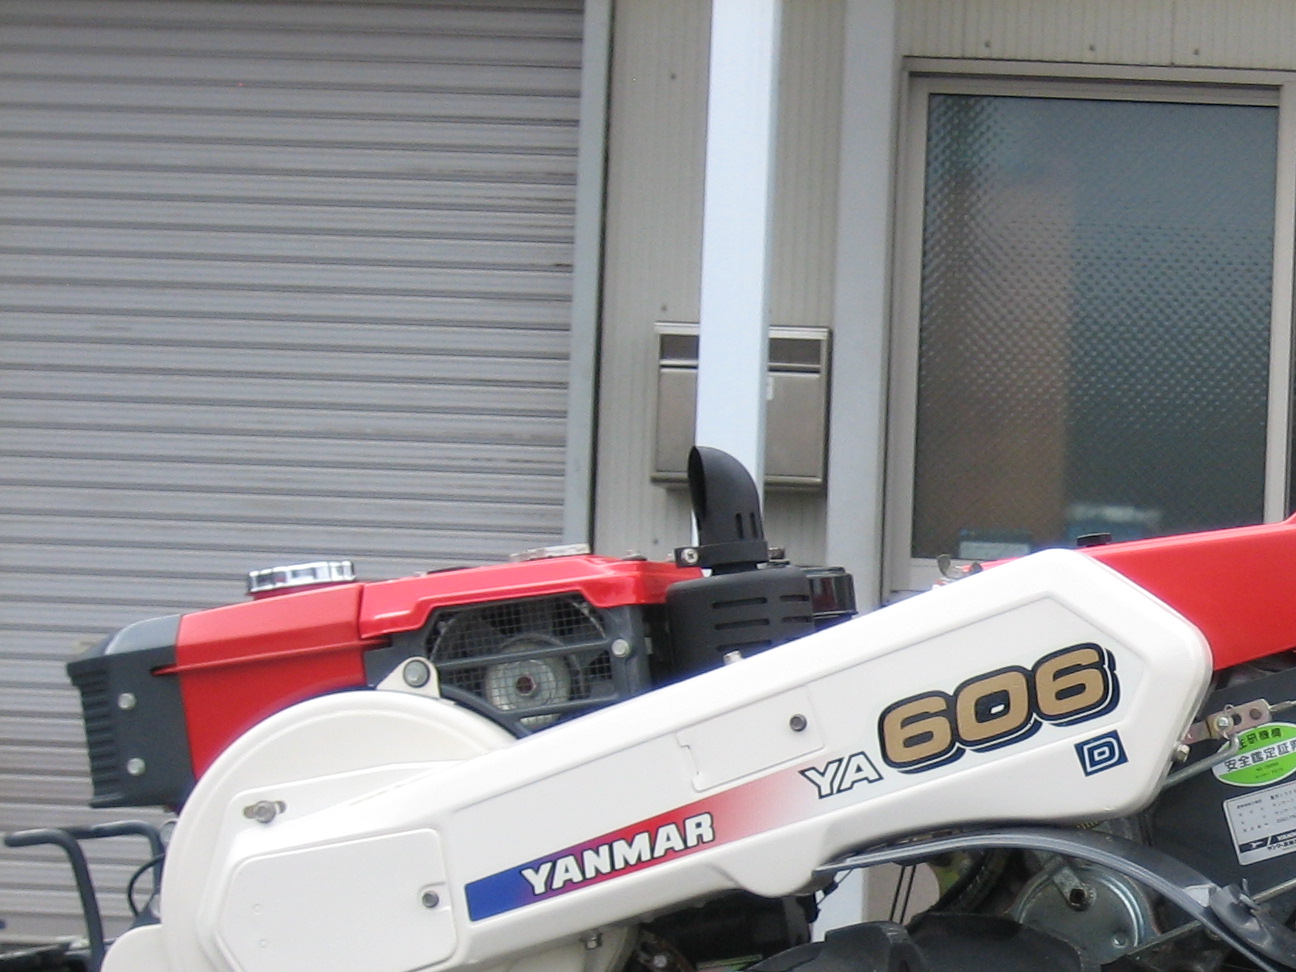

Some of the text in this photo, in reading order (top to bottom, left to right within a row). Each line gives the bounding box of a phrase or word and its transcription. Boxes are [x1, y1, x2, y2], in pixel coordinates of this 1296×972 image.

[797, 642, 1121, 800] YA 606
[519, 811, 715, 896] YANMAR
